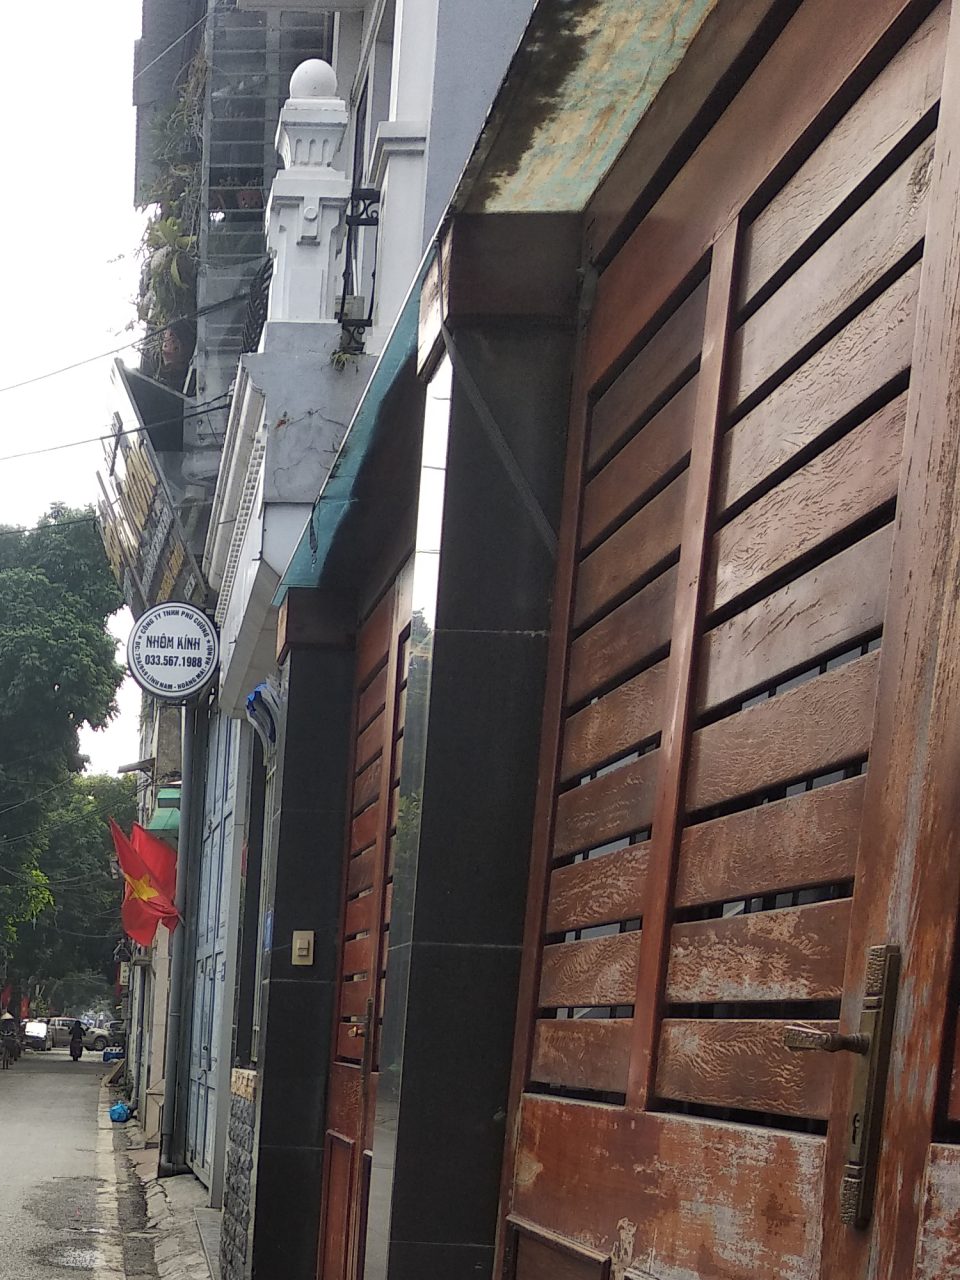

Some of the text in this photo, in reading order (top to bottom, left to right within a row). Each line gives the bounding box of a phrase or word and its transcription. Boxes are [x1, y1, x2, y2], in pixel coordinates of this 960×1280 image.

[154, 613, 162, 621] TY
[146, 632, 201, 650] NHÔM KÍNH
[144, 654, 203, 668] 033.567.1988
